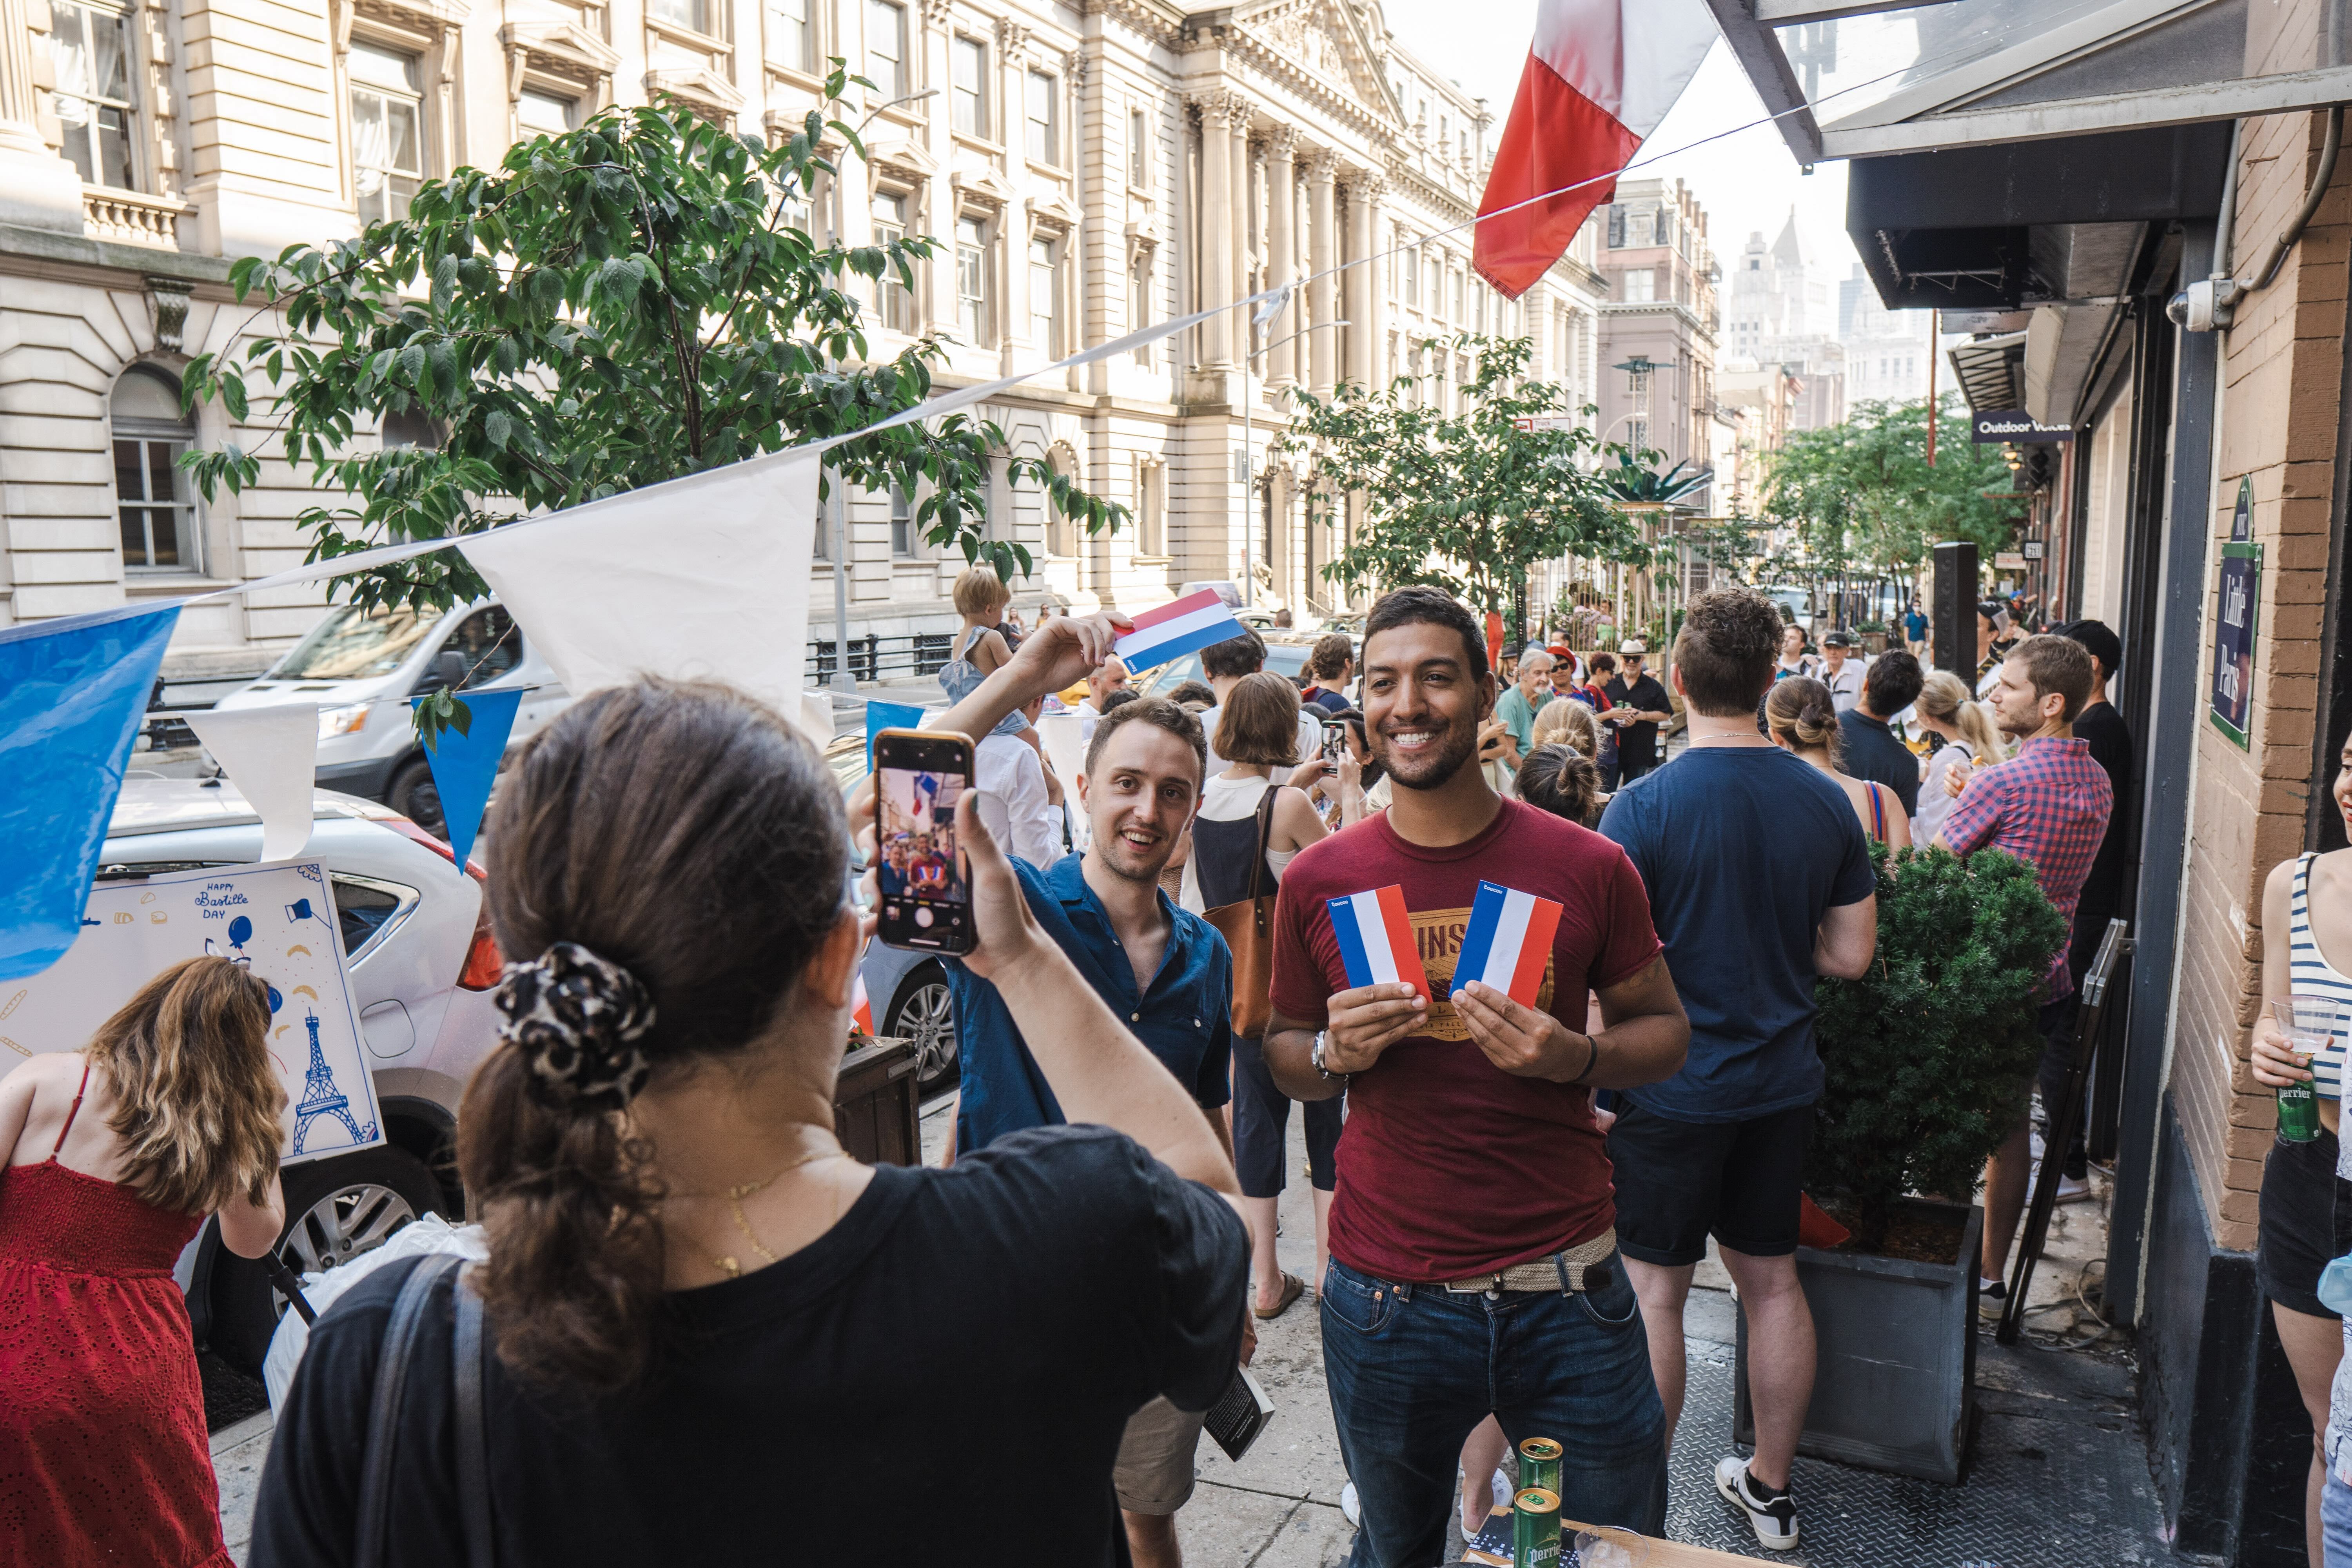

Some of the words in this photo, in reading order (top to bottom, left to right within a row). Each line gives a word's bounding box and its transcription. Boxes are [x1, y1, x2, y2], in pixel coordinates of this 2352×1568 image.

[1979, 421, 2031, 434] Outdoor
[2224, 574, 2246, 628] Little
[2219, 644, 2239, 702] Paris
[207, 883, 234, 892] HAPPY
[195, 891, 249, 906] Bastille
[203, 909, 225, 919] DAY
[2278, 1087, 2311, 1103] perrier
